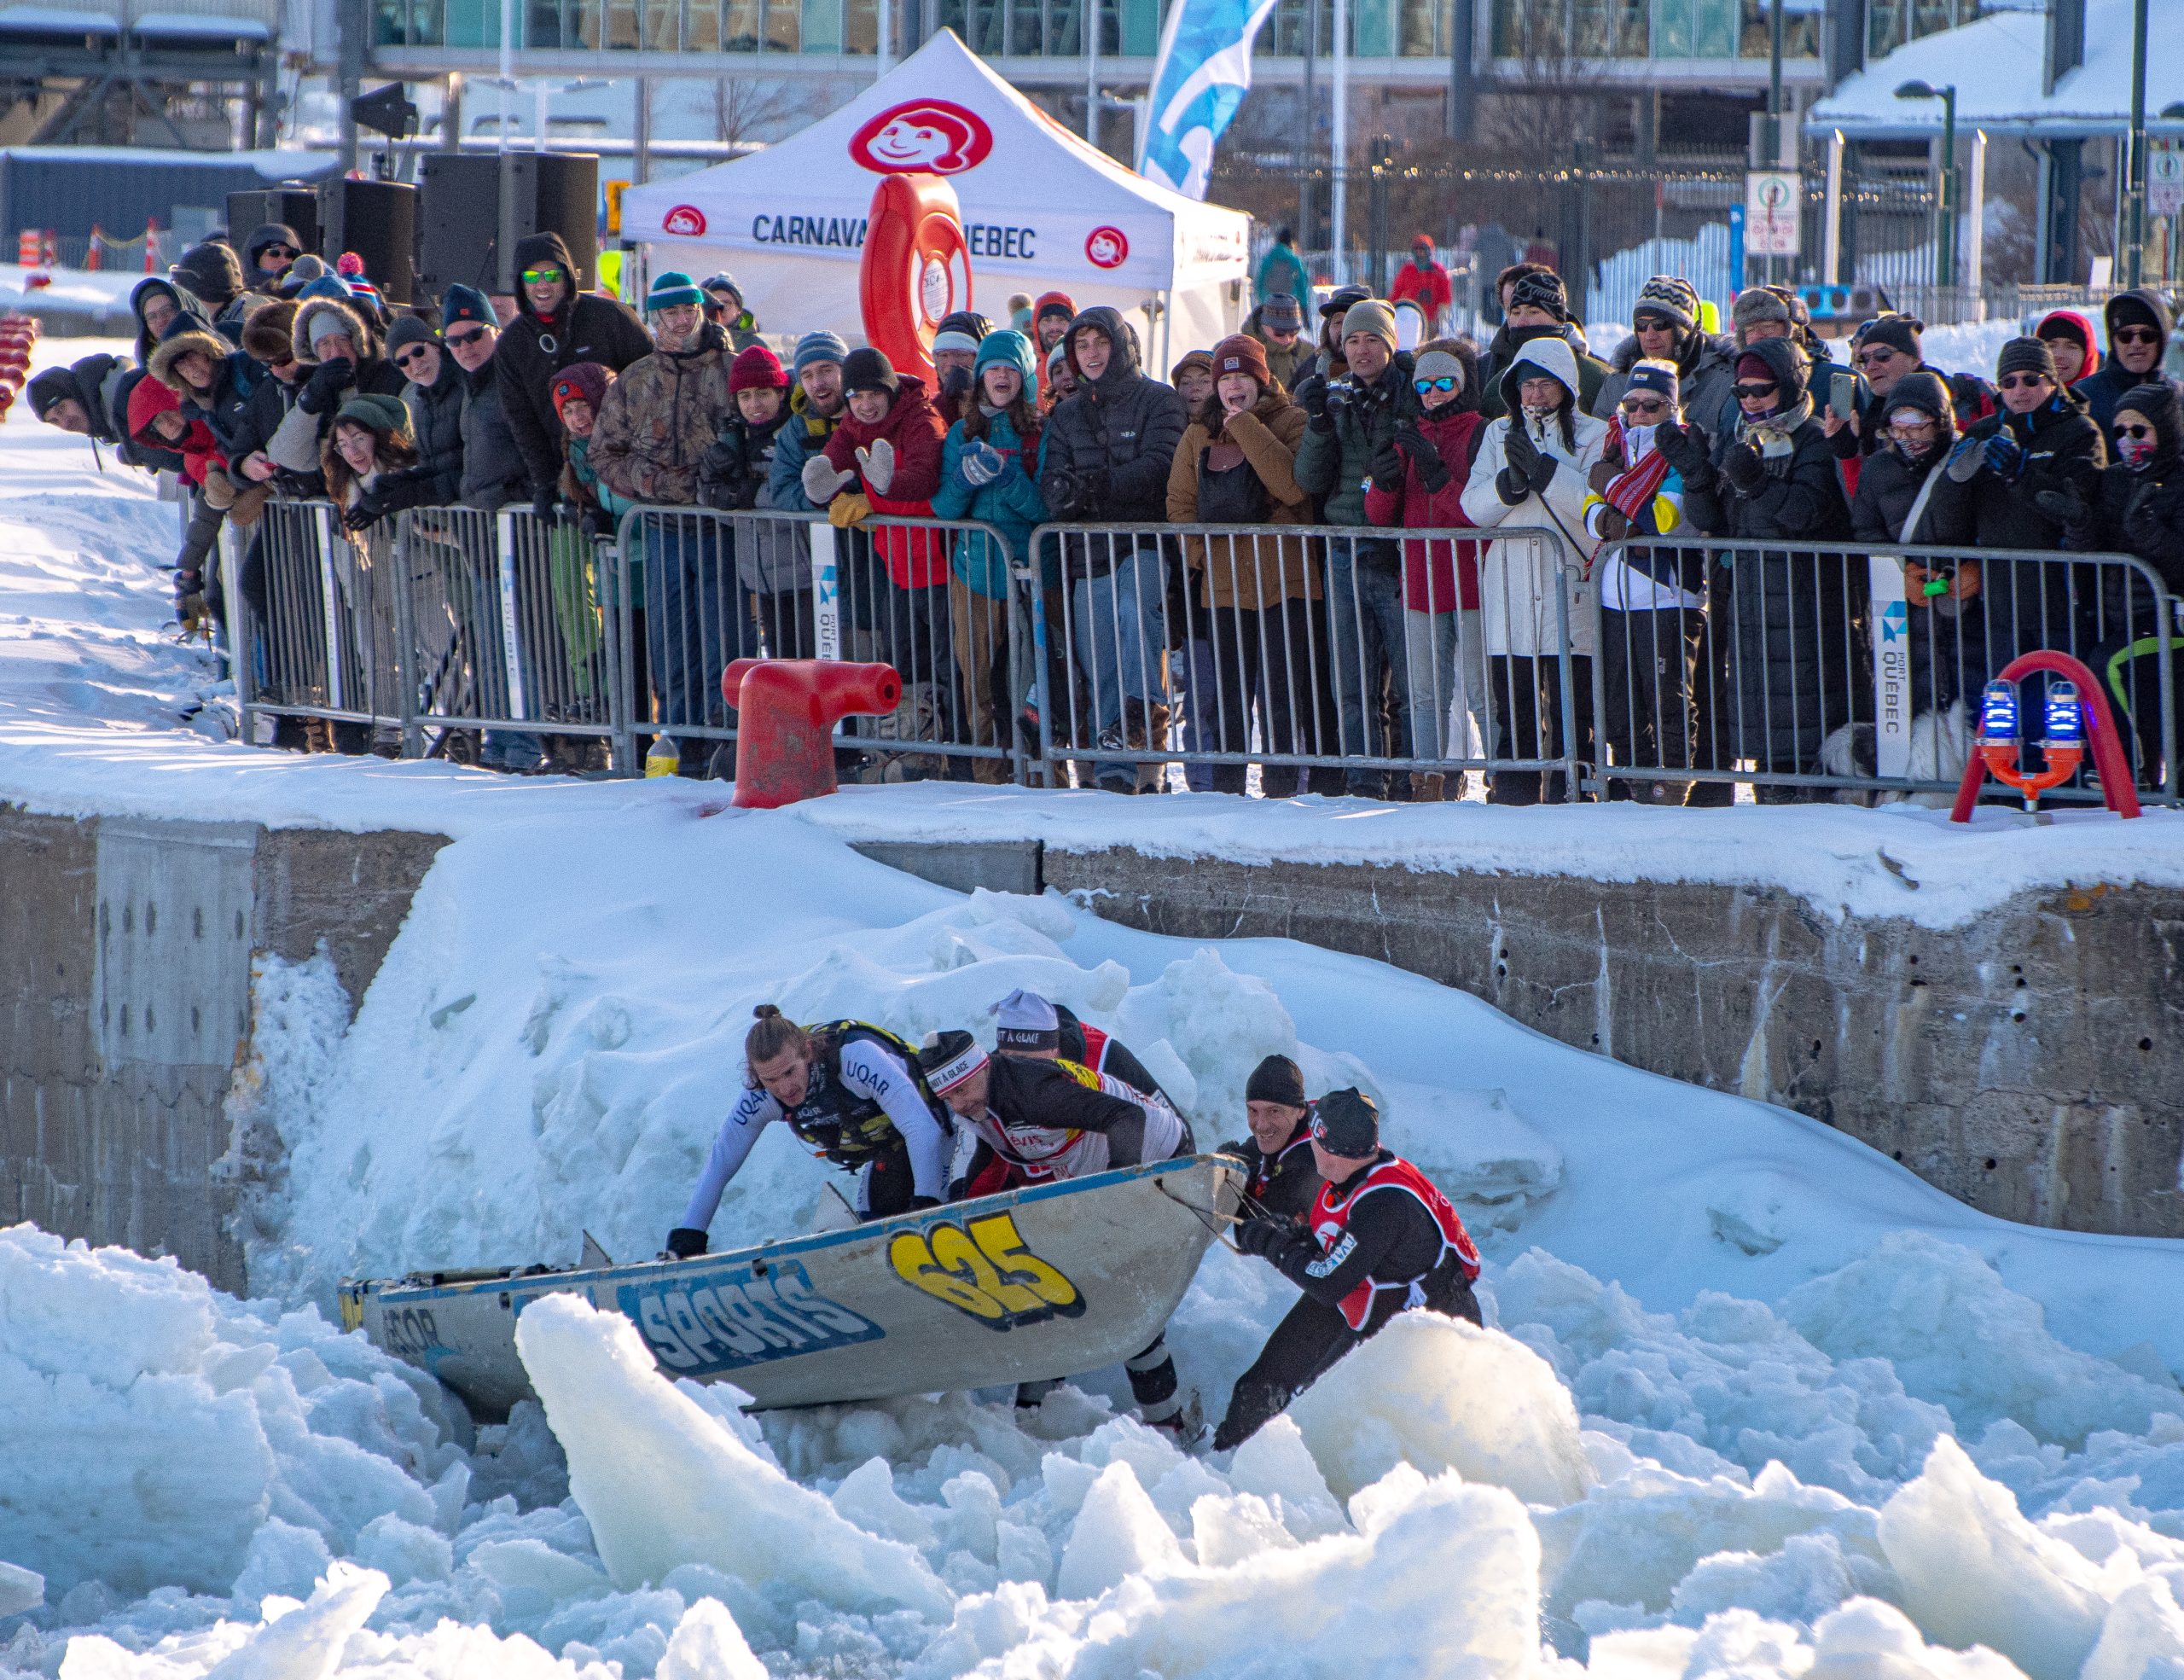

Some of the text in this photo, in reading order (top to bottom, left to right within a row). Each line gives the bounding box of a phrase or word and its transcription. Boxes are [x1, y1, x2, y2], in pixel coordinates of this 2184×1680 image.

[1897, 652, 1906, 682] PORT
[1882, 651, 1900, 734] QUÉBEC
[1015, 1032, 1039, 1044] GLACE
[846, 1061, 891, 1096] UQAR
[949, 1061, 969, 1080] GLACE
[888, 1211, 1082, 1328] 625
[640, 1275, 869, 1369] SPORTS
